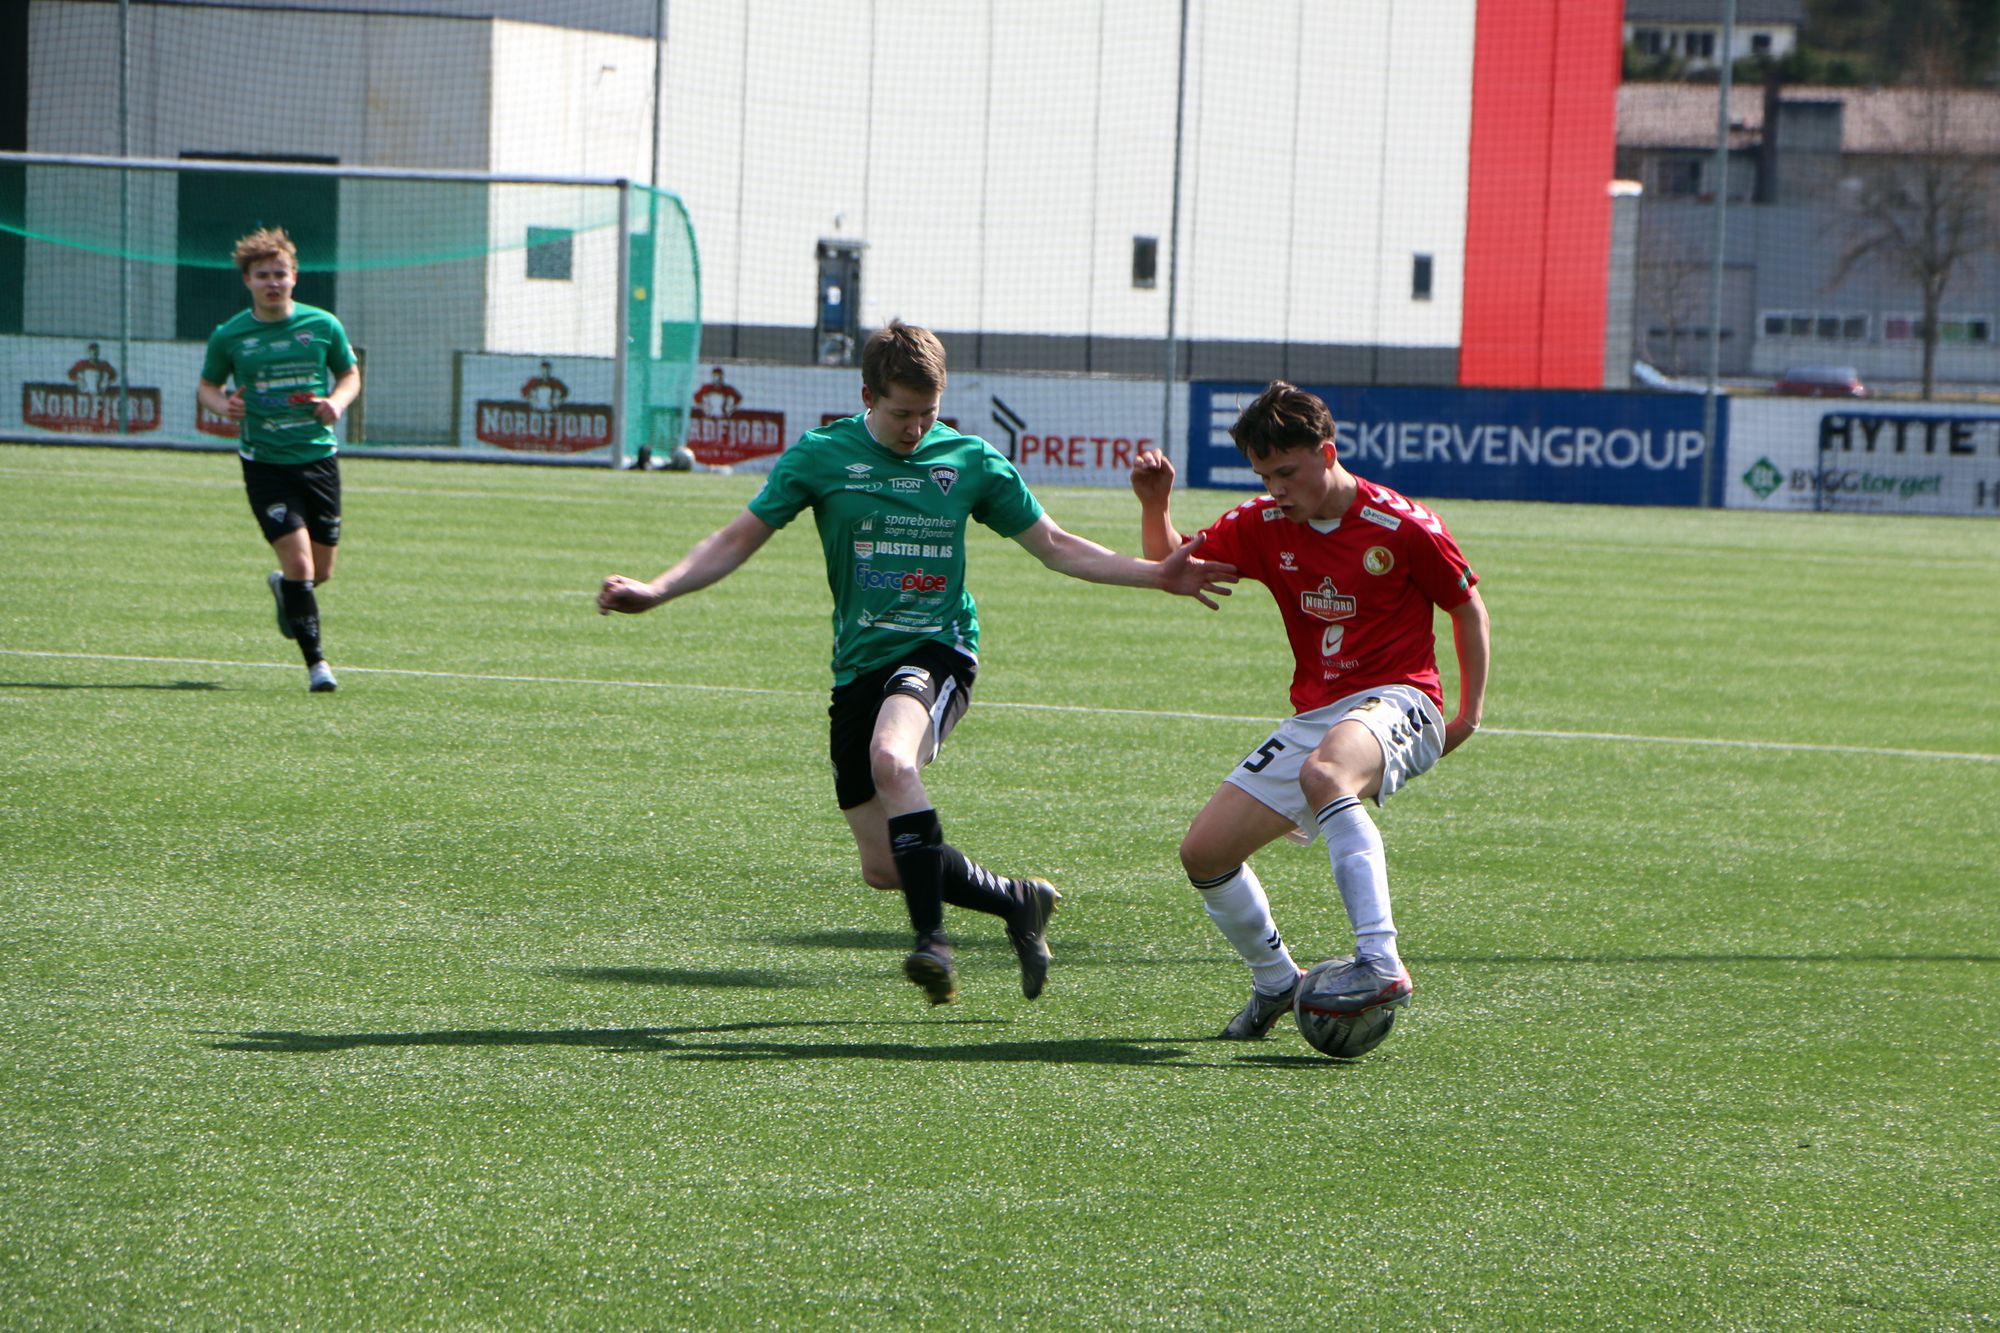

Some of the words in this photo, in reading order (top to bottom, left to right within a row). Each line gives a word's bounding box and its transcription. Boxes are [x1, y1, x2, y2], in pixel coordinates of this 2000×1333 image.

[482, 405, 608, 442] NORDFJORD
[1334, 421, 1705, 470] SKJERVENGROUP
[884, 514, 957, 528] sparebanken
[940, 545, 953, 558] AS
[1243, 738, 1286, 774] 5
